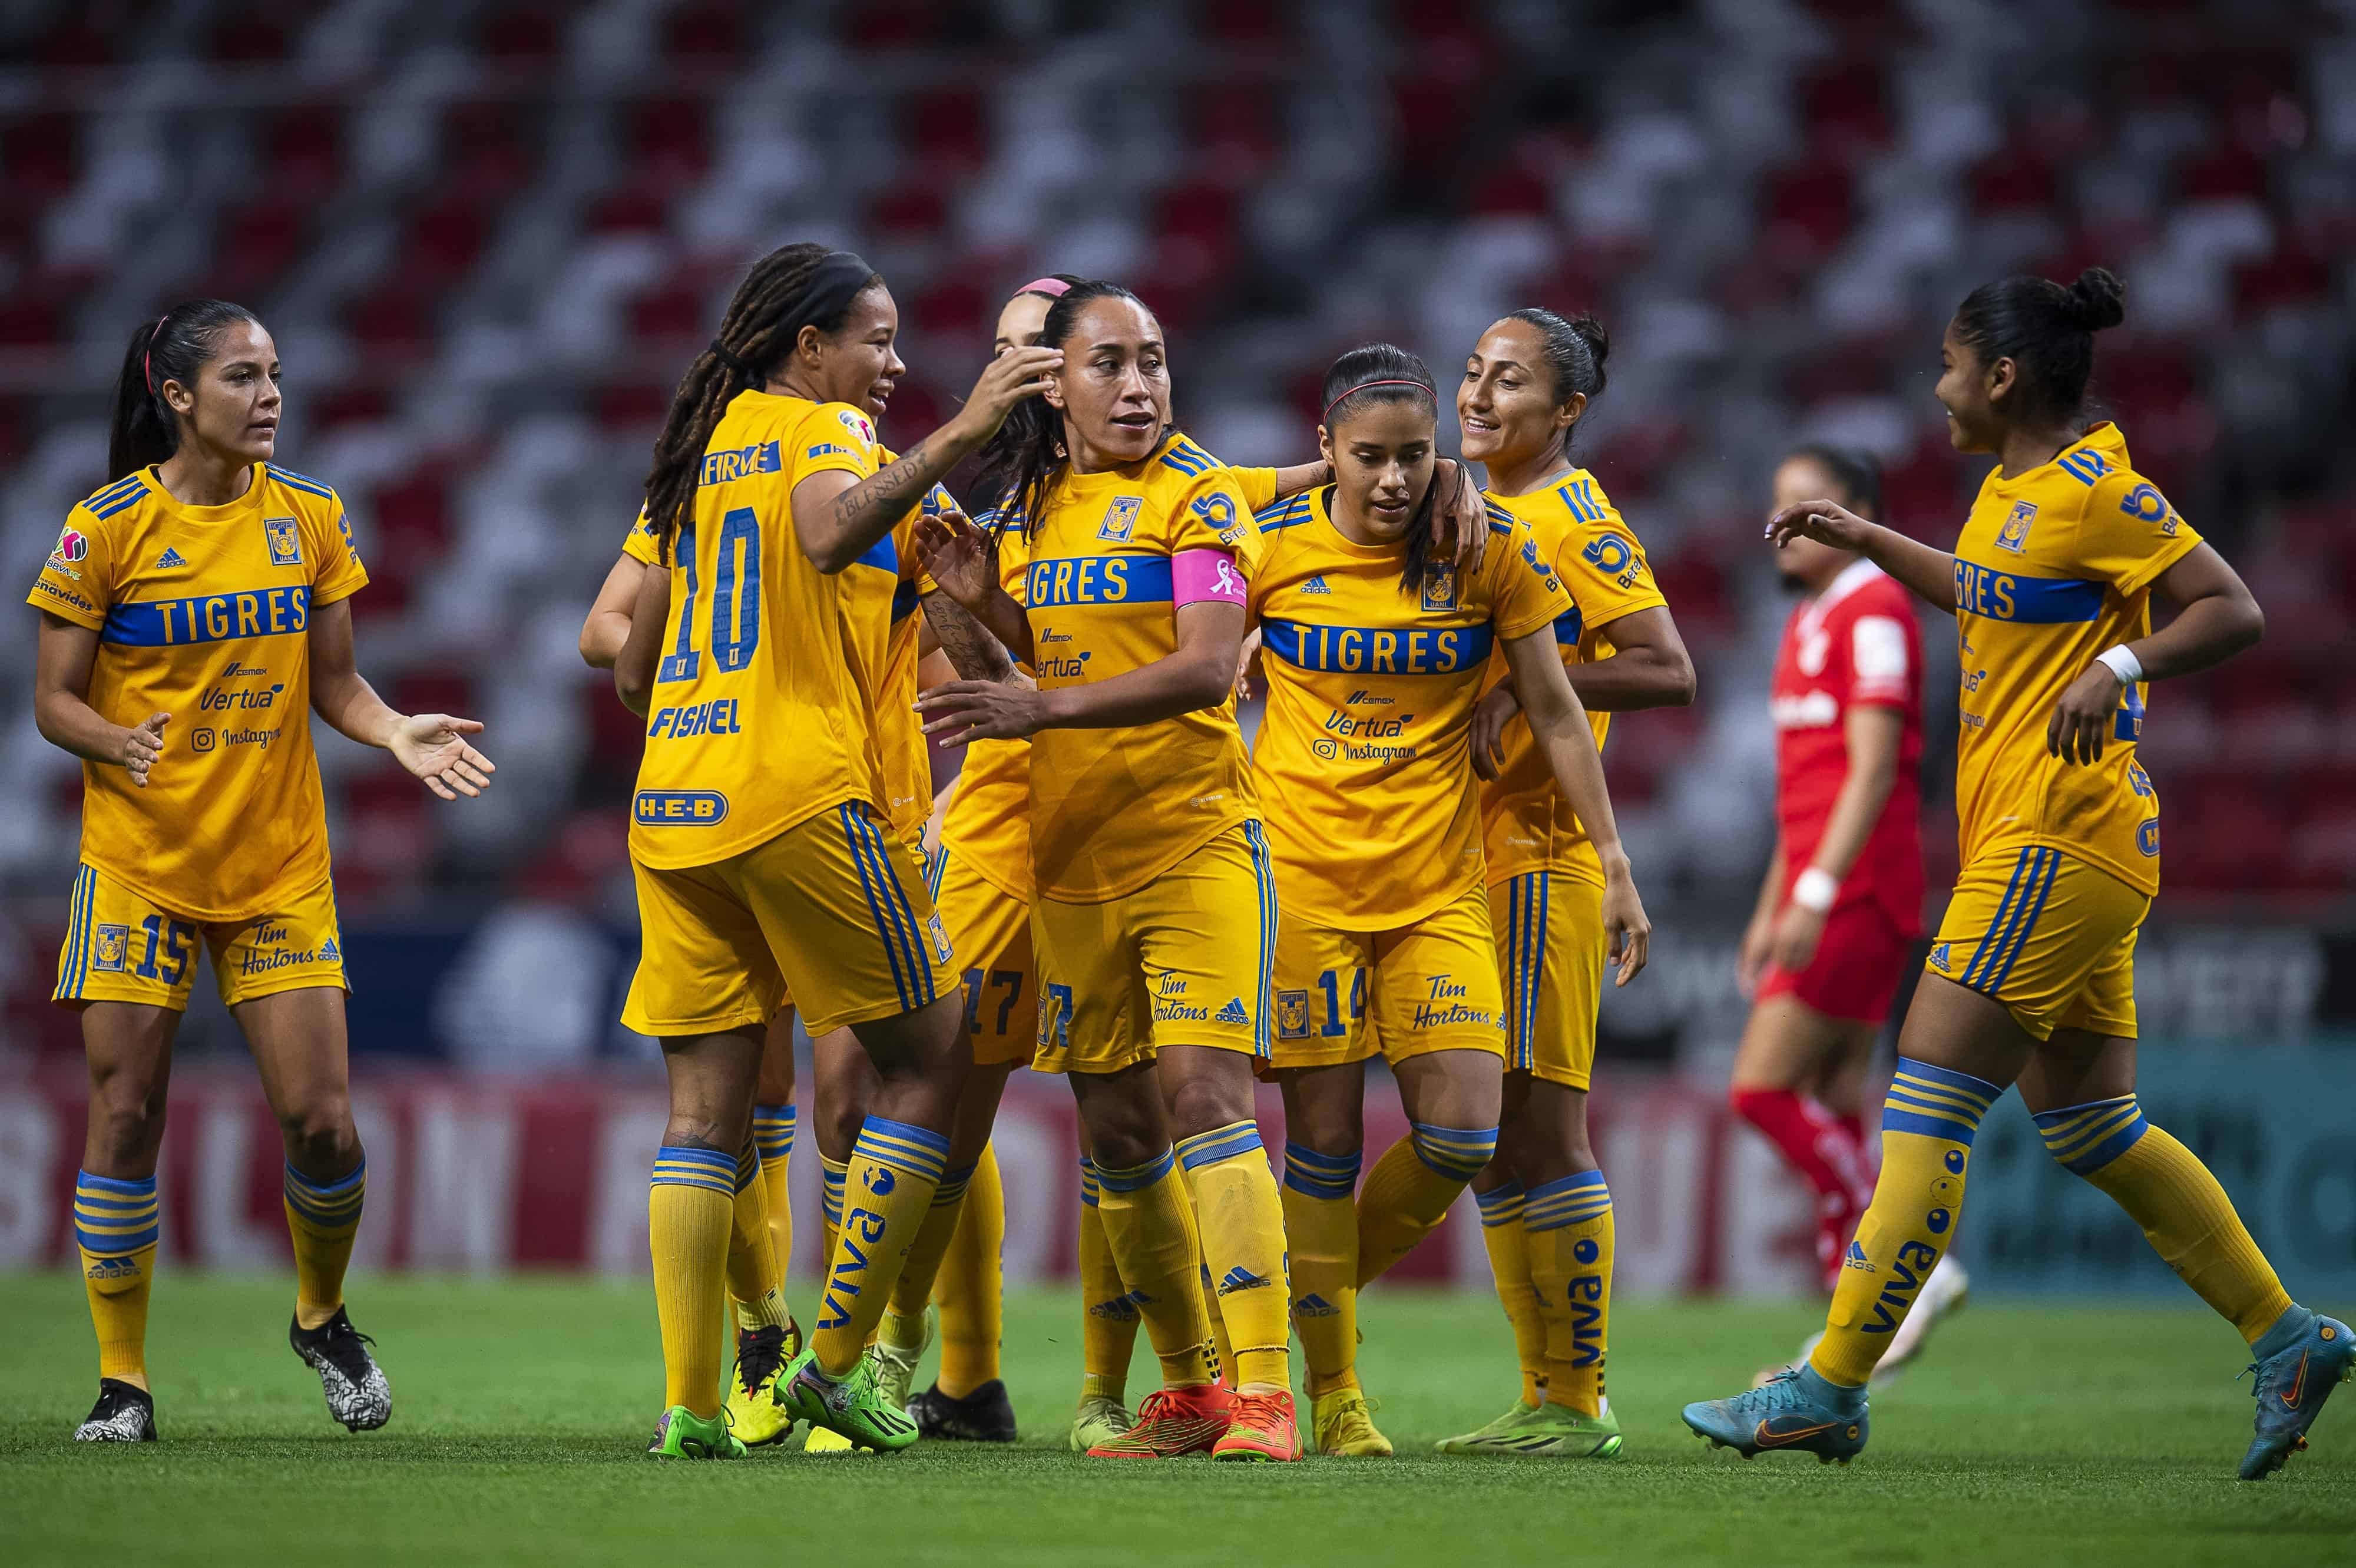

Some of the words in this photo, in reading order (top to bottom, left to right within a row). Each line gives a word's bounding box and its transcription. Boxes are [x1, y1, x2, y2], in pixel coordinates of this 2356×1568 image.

[699, 446, 769, 485] FIRME
[1219, 522, 1248, 545] Berel
[47, 560, 69, 575] BBVA
[156, 558, 186, 569] adidas
[1617, 554, 1643, 590] Berel
[34, 580, 92, 611] enavides
[659, 507, 760, 683] 10
[1301, 585, 1331, 594] adidas
[1954, 562, 2016, 618] GRES
[155, 588, 306, 644] TIGRES
[1293, 624, 1458, 673] TIGRES
[200, 687, 274, 711] Vertua
[648, 699, 741, 739] FISHEL
[1325, 709, 1402, 737] Vertua
[1344, 743, 1417, 765] Instagram
[640, 799, 716, 817] H-E-B
[252, 919, 287, 945] Tim
[135, 914, 197, 986] 15
[242, 947, 313, 976] Hortons
[1159, 970, 1187, 995] Tim
[1427, 974, 1466, 1000] Tim
[964, 968, 1023, 1036] 17
[1318, 967, 1367, 1037] 14
[1215, 1013, 1249, 1025] adidas
[1413, 1003, 1489, 1030] Hortons
[88, 1268, 141, 1279] adidas
